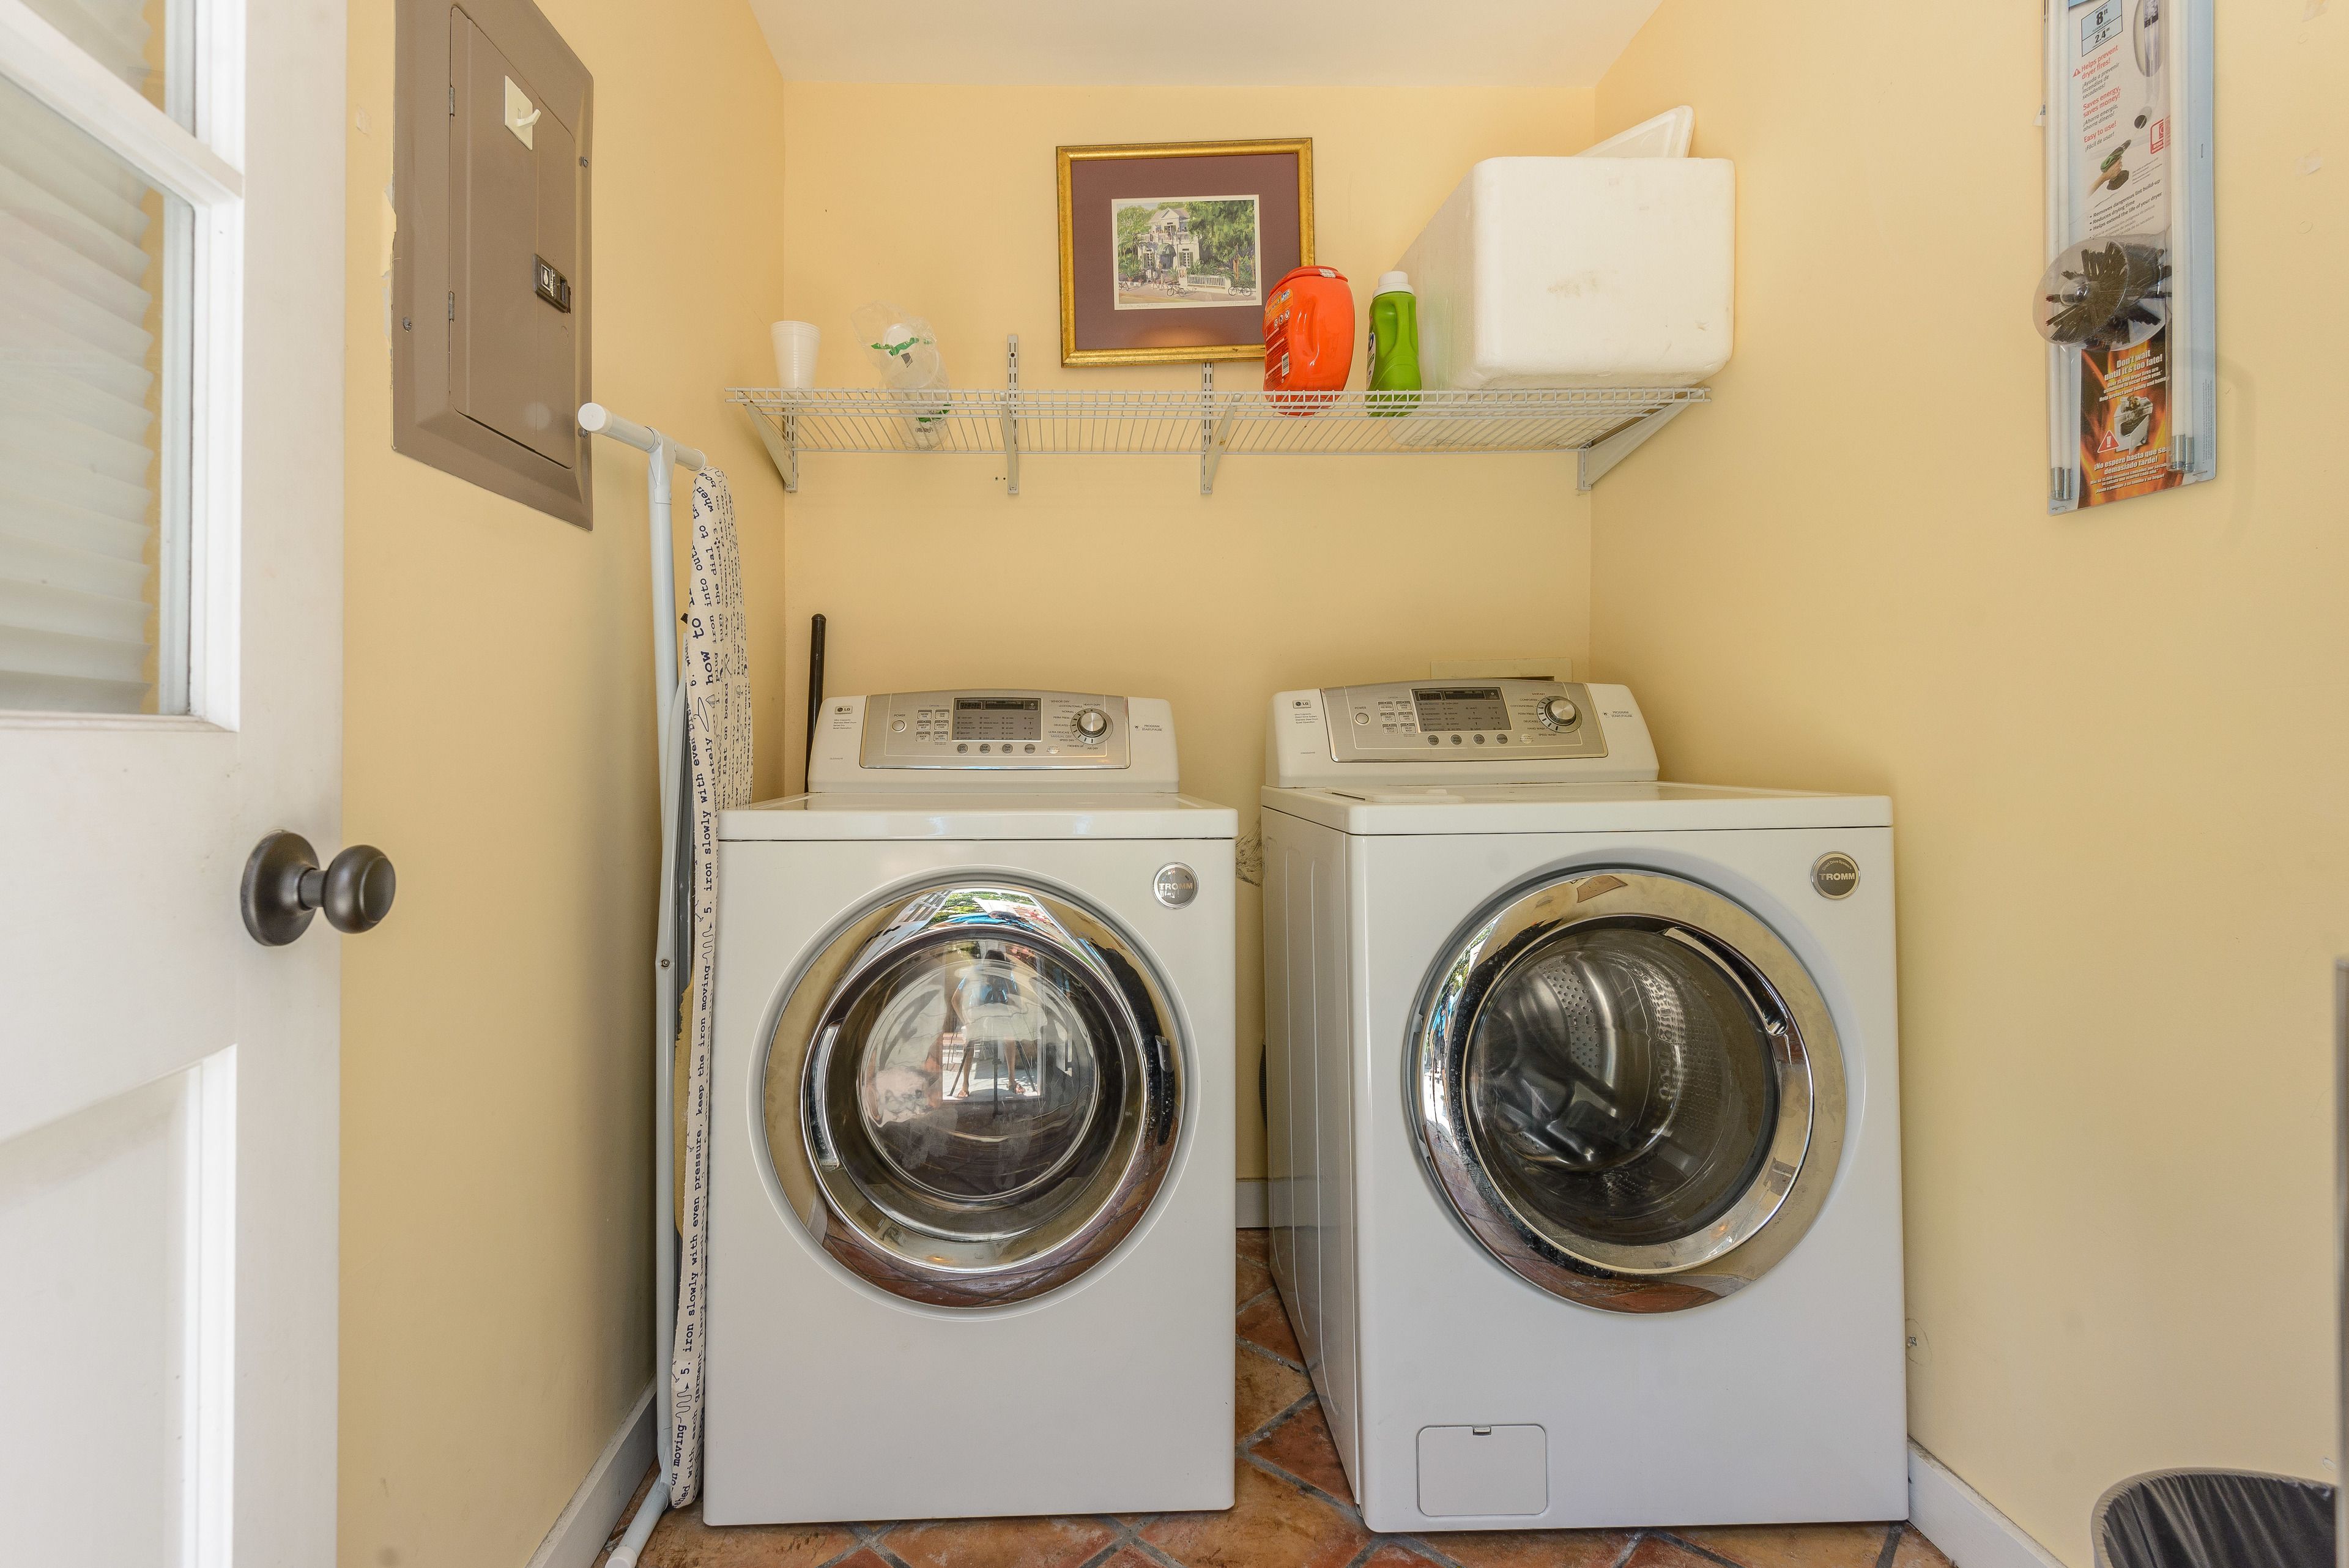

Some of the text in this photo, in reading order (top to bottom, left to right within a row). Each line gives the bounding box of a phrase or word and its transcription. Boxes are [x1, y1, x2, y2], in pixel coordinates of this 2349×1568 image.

[2082, 45, 2118, 72] Helps prevent
[2082, 58, 2110, 80] dryer fires!
[2101, 63, 2119, 76] prevenir
[2082, 79, 2102, 94] incendios
[2082, 83, 2106, 100] secadoras!
[2083, 86, 2121, 110] Saves energy,
[2084, 92, 2120, 117] saves money!
[2083, 114, 2099, 127] ¡Ahorra
[2083, 111, 2115, 132] ahorra dinero!
[2084, 133, 2096, 143] Easy
[2104, 121, 2117, 132] use!
[2103, 132, 2115, 141] usar!
[2093, 206, 2112, 218] Removes
[2113, 195, 2135, 207] dangerous
[2143, 179, 2160, 191] build-up
[2106, 214, 2121, 224] extend
[2151, 192, 2162, 201] dryer
[2093, 213, 2111, 224] Reduces
[2112, 206, 2125, 216] drying
[2104, 354, 2162, 381] until it's too late!
[2117, 350, 2151, 368] Don't wait
[2094, 450, 2157, 471] ¡No espere hasta que
[2104, 456, 2158, 475] demasiado tarde!
[696, 486, 714, 513] when
[716, 496, 720, 510] on
[699, 526, 709, 538] to
[706, 546, 717, 575] dial
[700, 578, 711, 607] into
[737, 612, 740, 630] to
[692, 618, 714, 685] how to
[724, 726, 728, 740] on
[705, 738, 718, 818] immediately
[690, 737, 712, 914] 5. iron slowly with even
[700, 965, 710, 1011] moving
[696, 1085, 705, 1116] keep
[694, 1124, 702, 1191] pressure,
[689, 1233, 698, 1265] with
[685, 1272, 700, 1317] slowly
[683, 1323, 694, 1353] iron
[680, 1362, 691, 1375] 5.
[674, 1424, 686, 1467] moving
[686, 1446, 696, 1478] with
